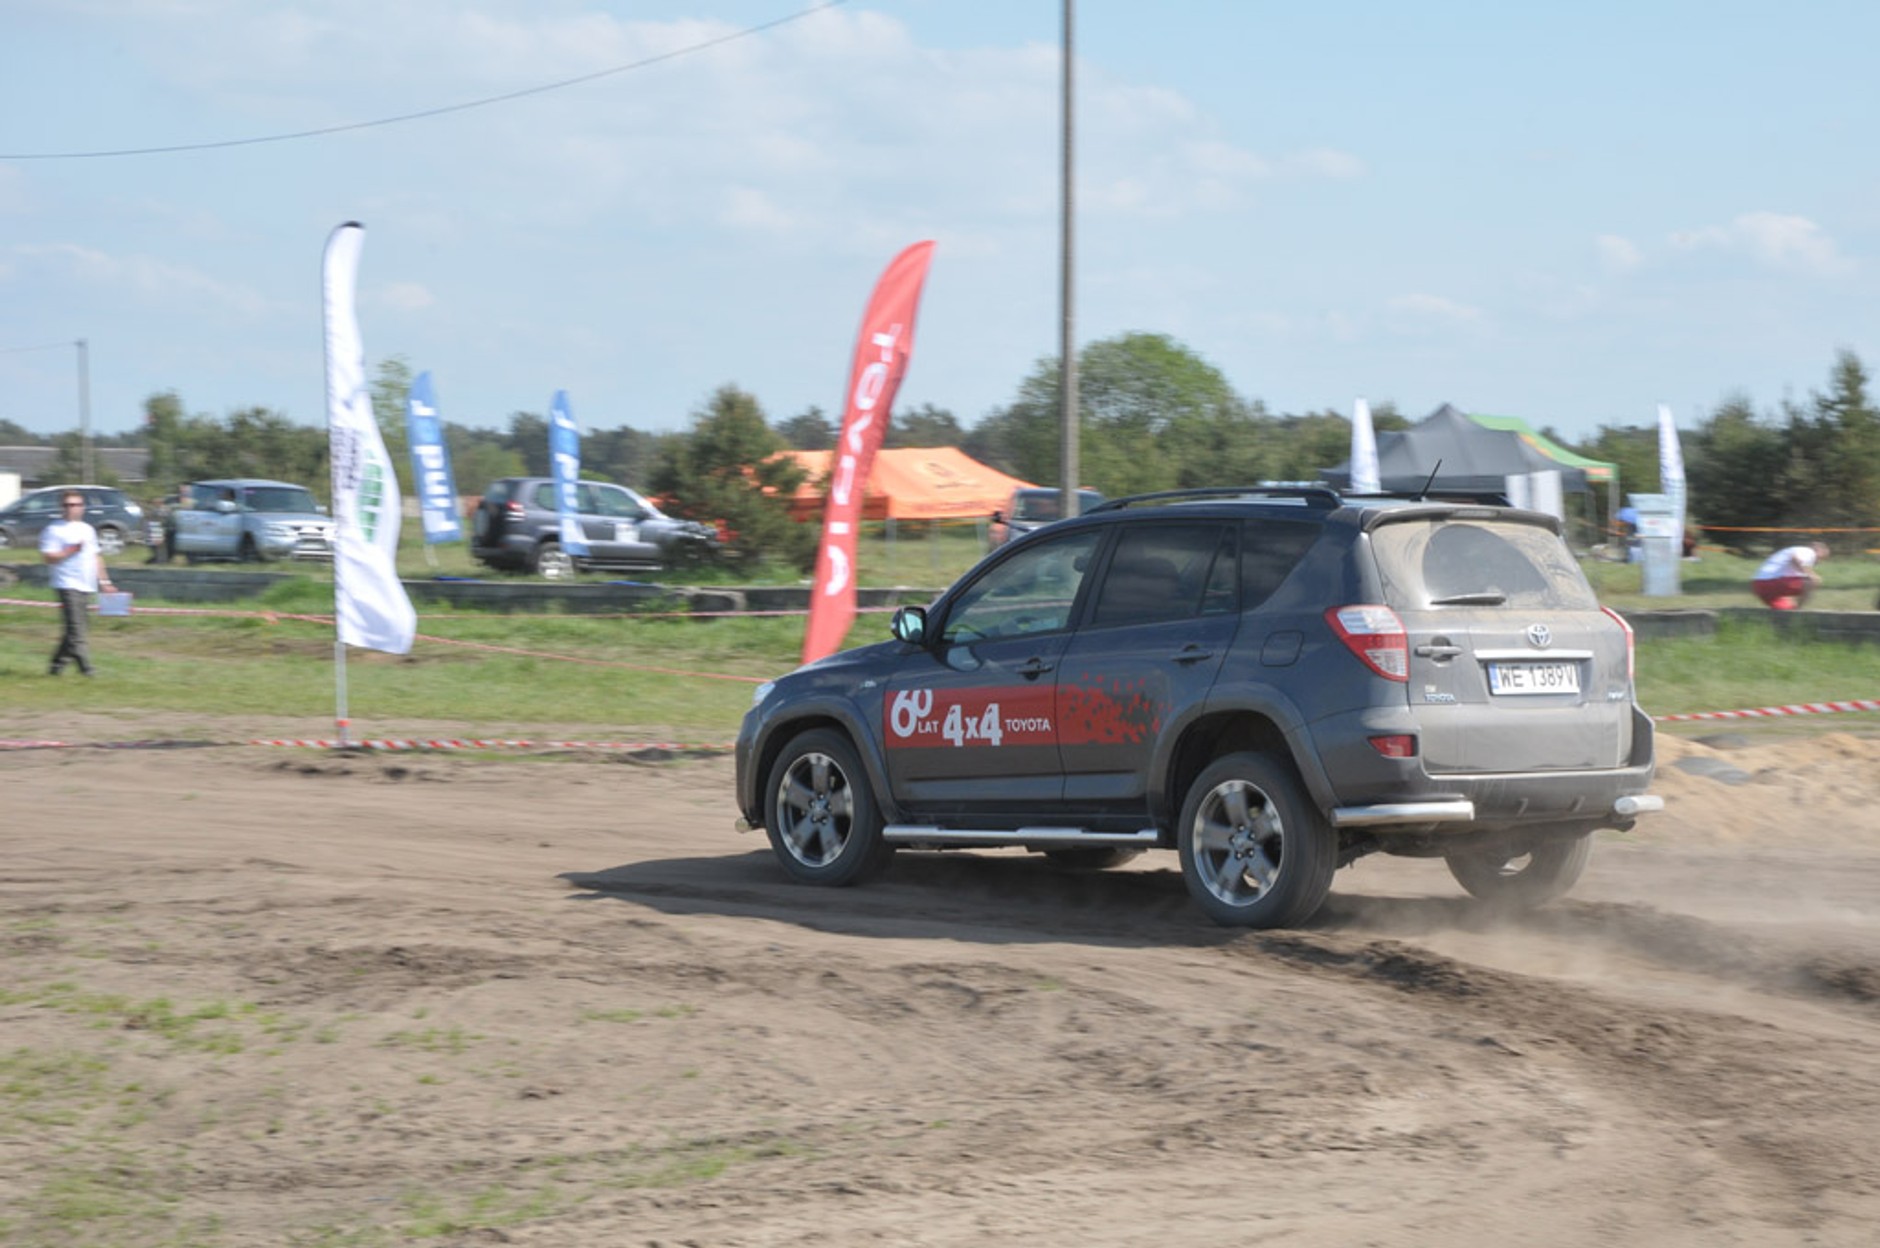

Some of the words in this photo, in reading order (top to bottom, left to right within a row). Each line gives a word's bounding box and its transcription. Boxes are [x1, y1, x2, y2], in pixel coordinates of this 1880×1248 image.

[1499, 665, 1524, 687] WE
[890, 689, 933, 738] 60
[918, 720, 939, 733] LAT
[942, 703, 1003, 746] 4x4
[1005, 718, 1051, 731] TOYOTA
